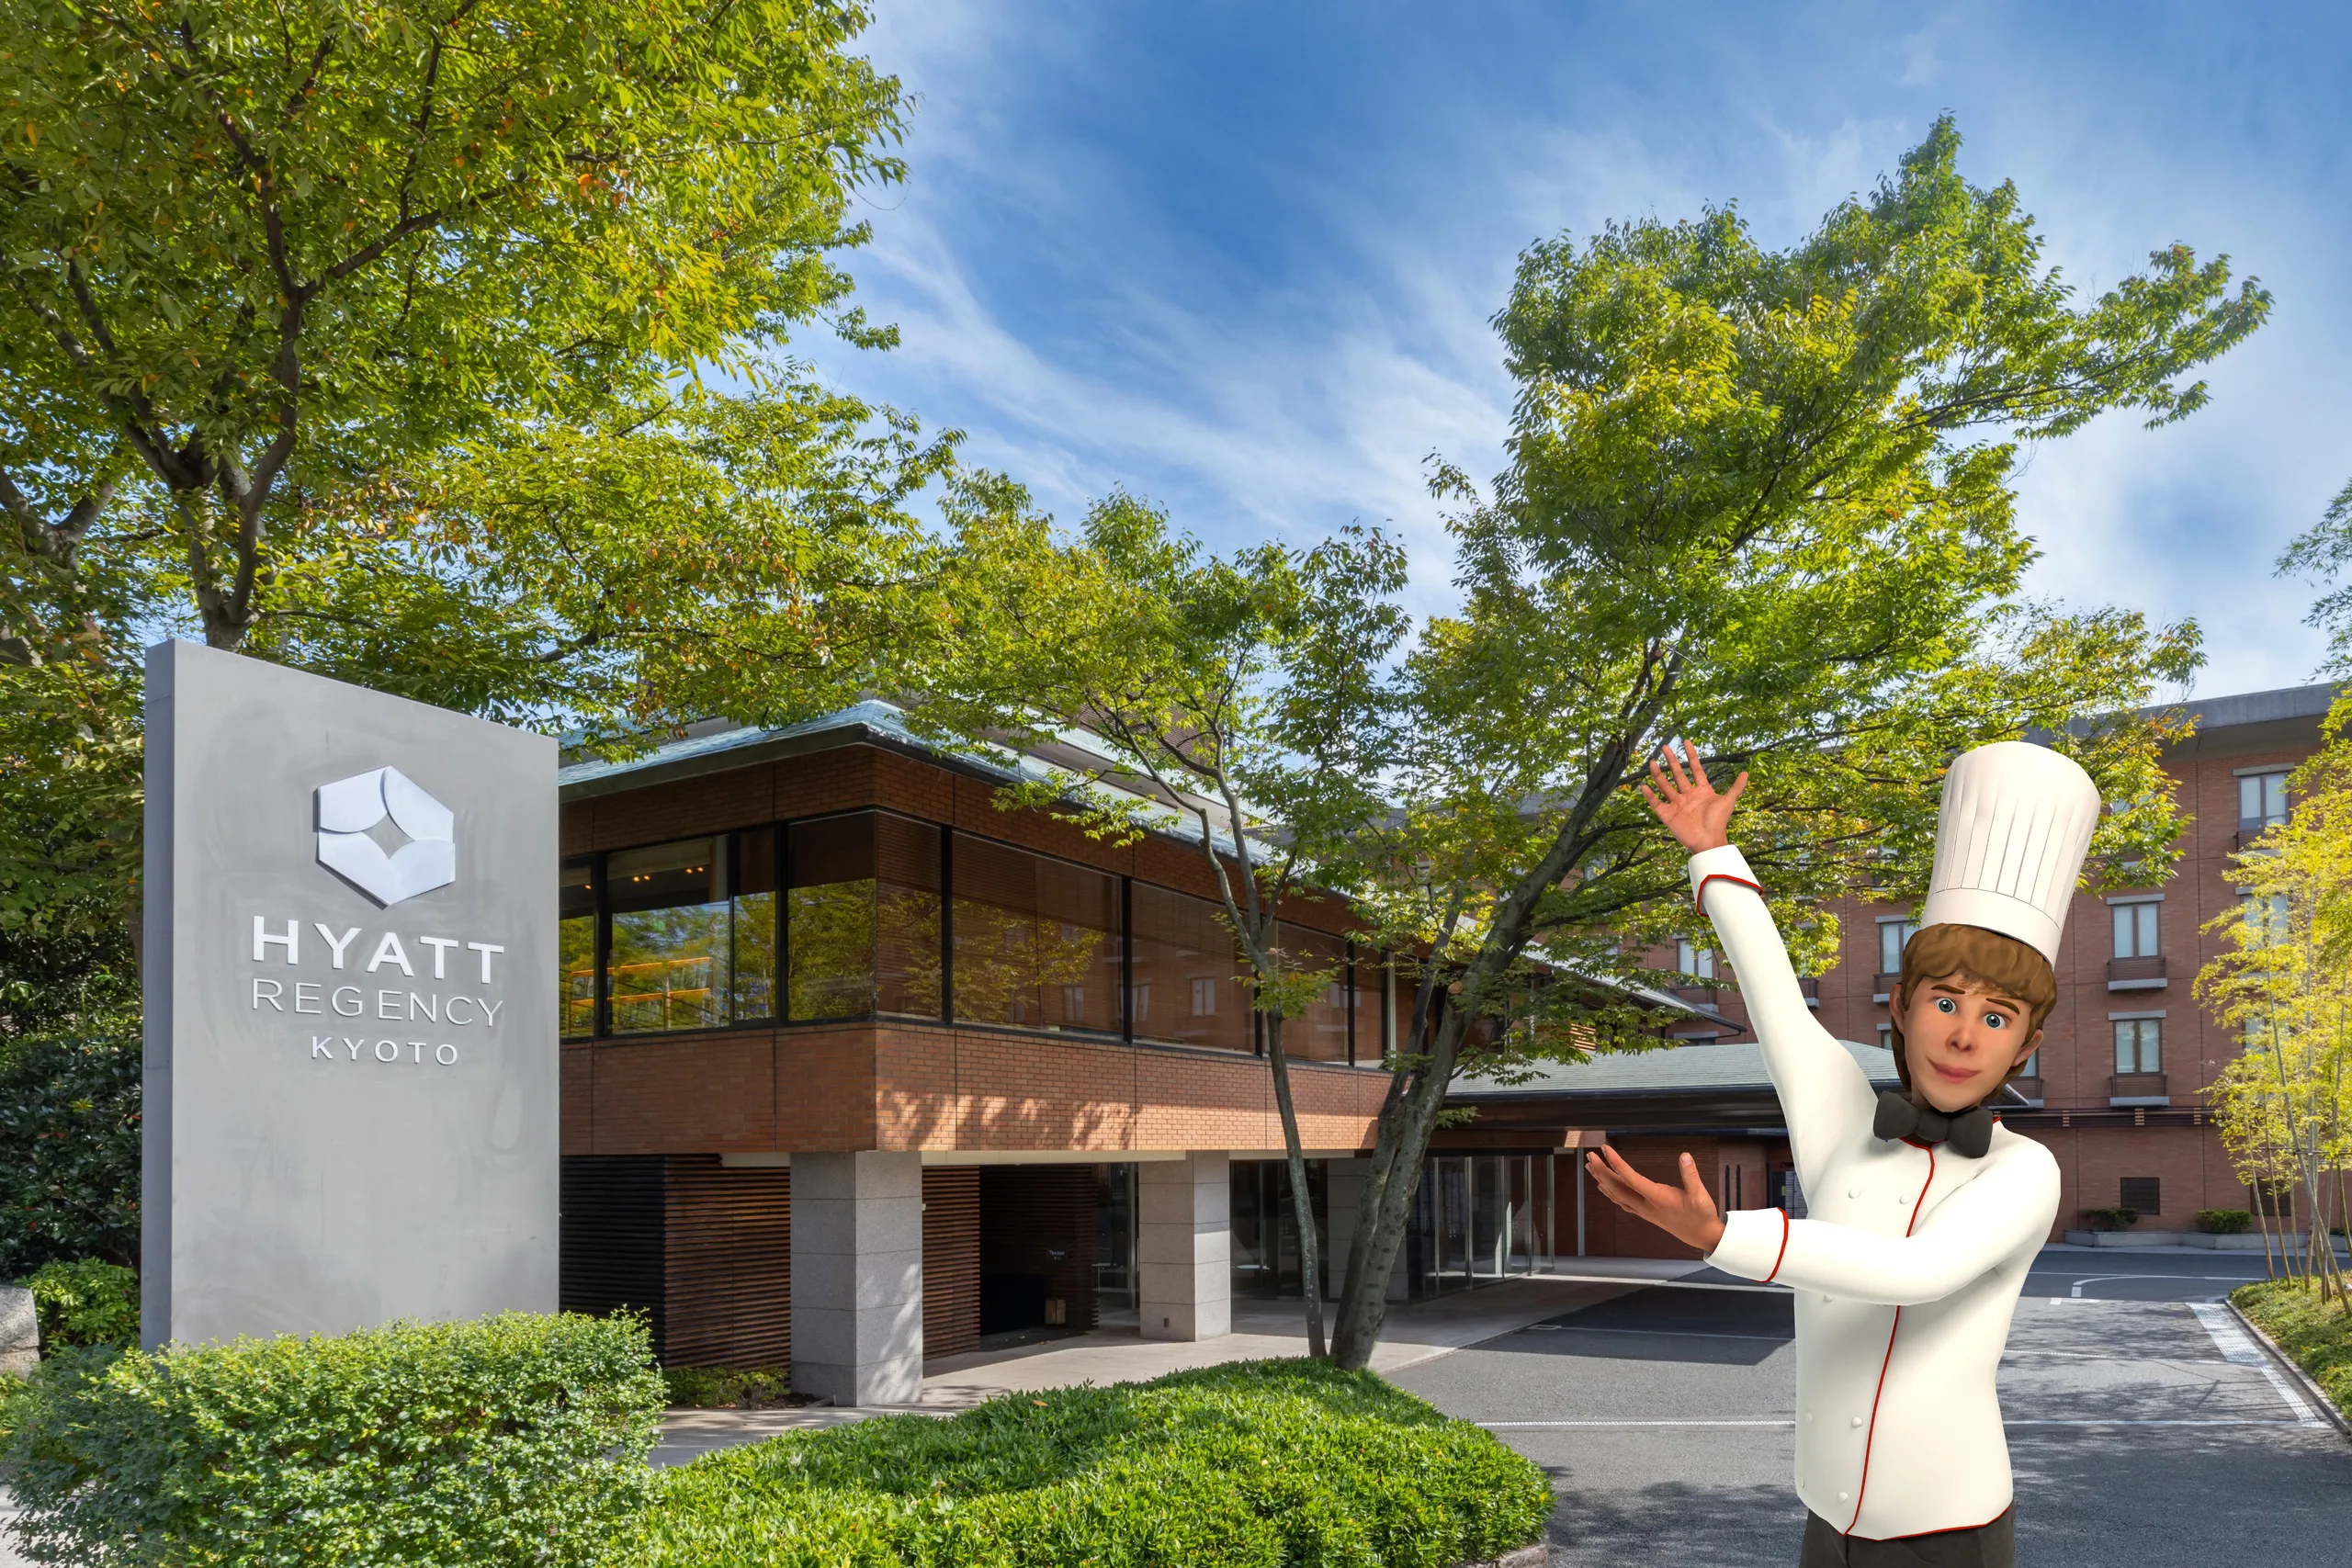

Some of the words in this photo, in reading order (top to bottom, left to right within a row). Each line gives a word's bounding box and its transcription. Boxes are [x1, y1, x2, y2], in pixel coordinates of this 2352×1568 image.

[252, 915, 504, 985] HYATT
[252, 977, 504, 1028] REGENCY
[311, 1035, 458, 1066] KYOTO
